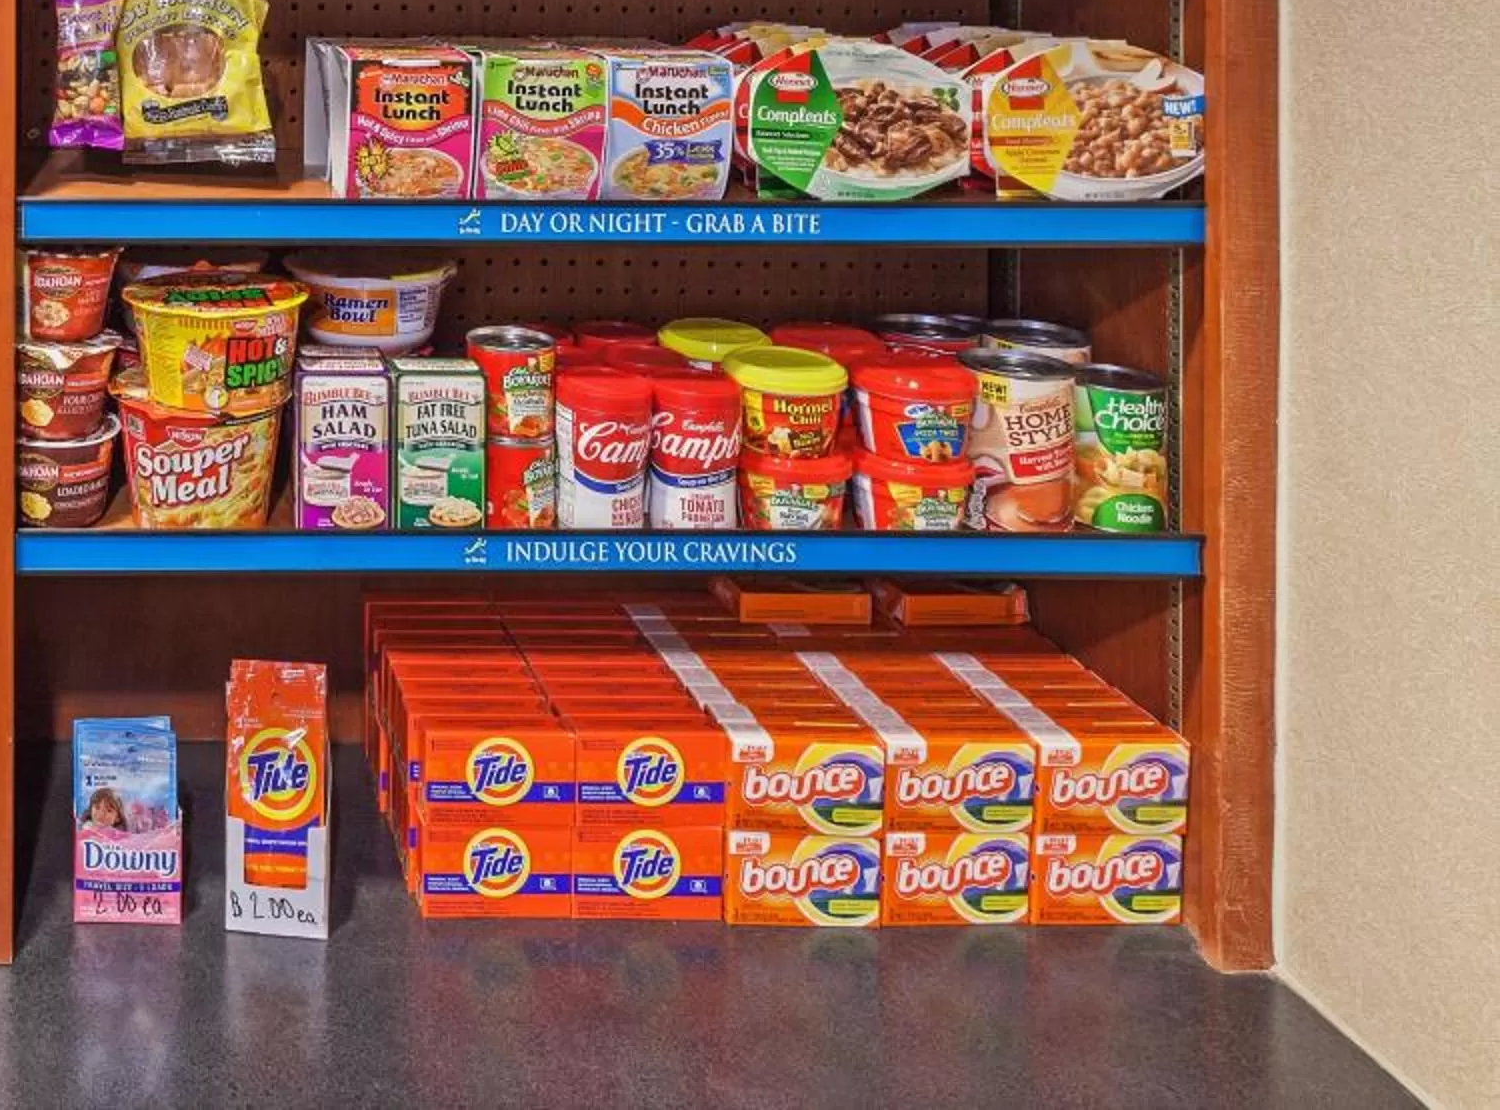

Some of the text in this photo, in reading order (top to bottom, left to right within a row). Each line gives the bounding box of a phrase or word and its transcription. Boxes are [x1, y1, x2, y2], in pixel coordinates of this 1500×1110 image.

[374, 89, 450, 105] Instant
[508, 80, 583, 98] Instant
[635, 83, 710, 99] Instant
[383, 105, 442, 121] Lunch
[515, 97, 574, 112] Lunch
[644, 99, 701, 115] Lunch
[1164, 99, 1197, 115] NEW!
[642, 116, 700, 136] Chicken
[654, 142, 685, 160] 35%
[500, 213, 821, 234] DAY OR NIGHT GRAB A BITE
[323, 292, 389, 309] Ramen
[329, 306, 376, 323] Bowl
[229, 338, 274, 363] HOT
[321, 403, 368, 419] HAM
[417, 403, 467, 418] FAT FREE
[773, 398, 833, 414] Hormel
[1004, 404, 1072, 431] HOME
[312, 421, 377, 439] SALAD
[406, 422, 478, 439] TUNA SALAD
[789, 413, 822, 425] Chili
[1095, 409, 1165, 432] Choice
[1009, 421, 1073, 447] STYLE
[136, 436, 248, 476] Souper
[151, 463, 231, 505] Meal
[506, 541, 798, 564] INDULGE YOUR CRAVINGS
[247, 752, 309, 802] Tide
[472, 754, 528, 794] Tide
[623, 754, 678, 794] Tide
[743, 764, 860, 803] bounce
[898, 764, 1011, 803] bounce
[1053, 765, 1164, 804] bounce
[83, 841, 177, 877] Downy
[468, 847, 524, 884] Tide
[620, 847, 675, 886] Tide
[741, 855, 856, 895] bounce
[897, 855, 1008, 895] bounce
[1048, 855, 1158, 894] bounce
